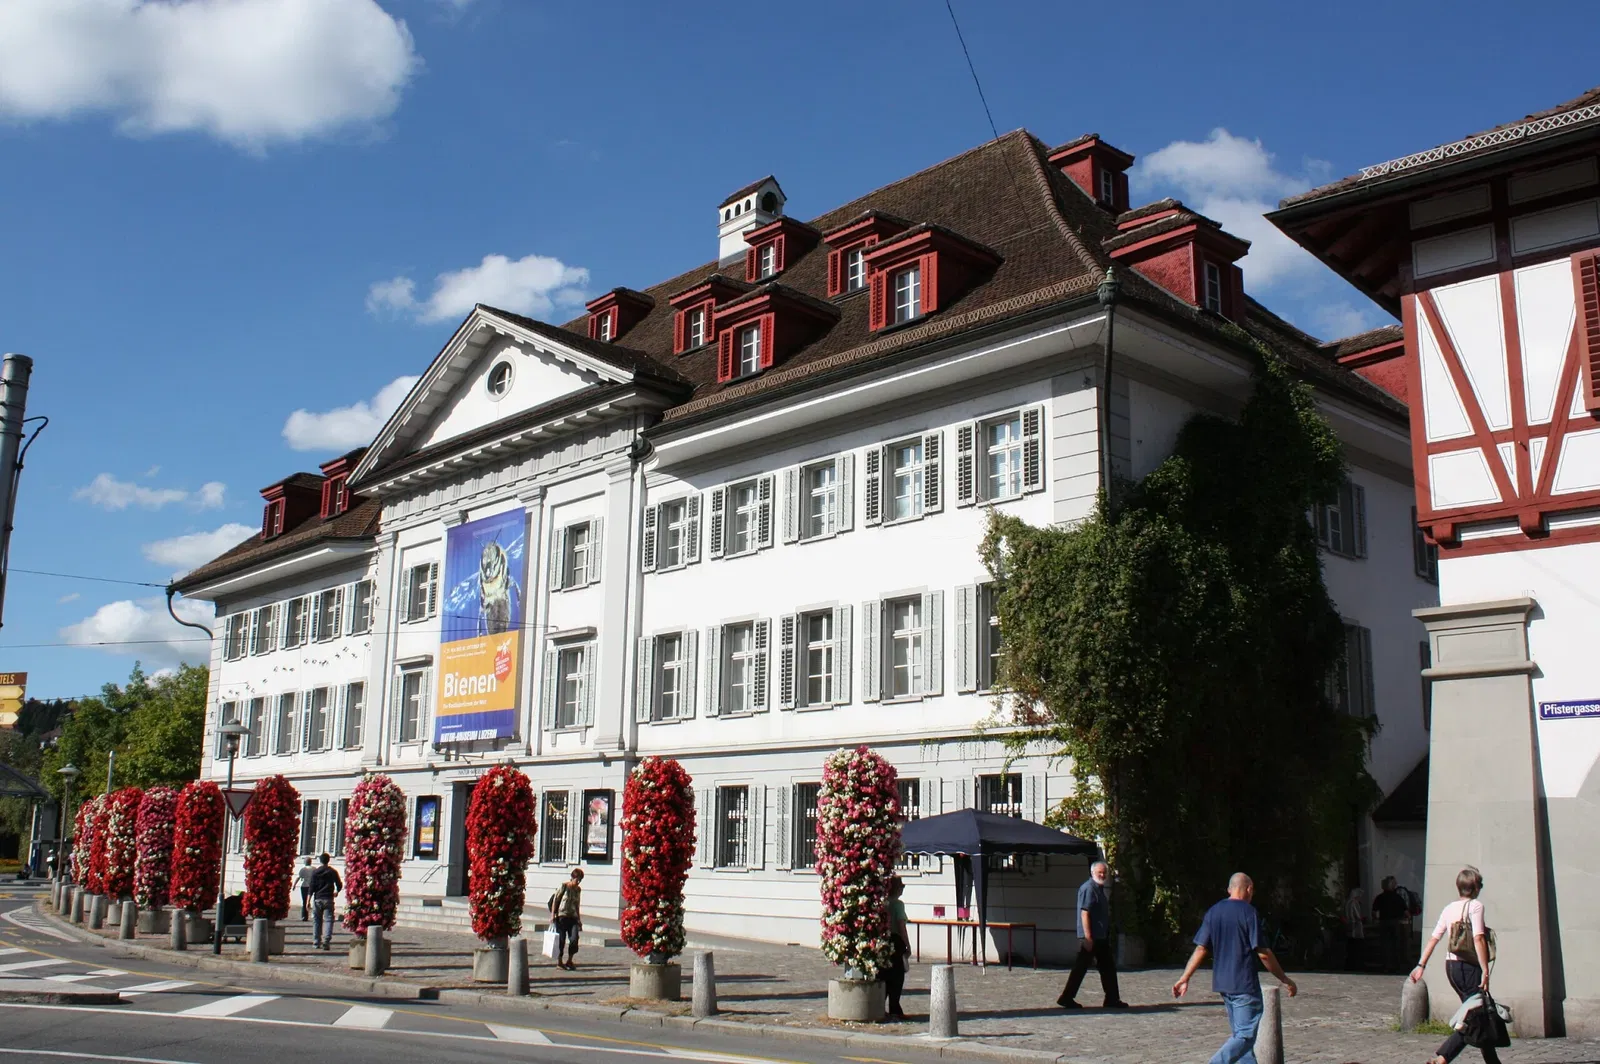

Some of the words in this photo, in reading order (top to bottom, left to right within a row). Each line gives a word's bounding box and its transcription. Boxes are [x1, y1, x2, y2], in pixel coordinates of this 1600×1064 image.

[444, 672, 497, 698] Bienen
[1543, 703, 1600, 716] Pfistergasse
[440, 730, 478, 742] NATUR-MUSEUM
[478, 729, 497, 739] LUZERN
